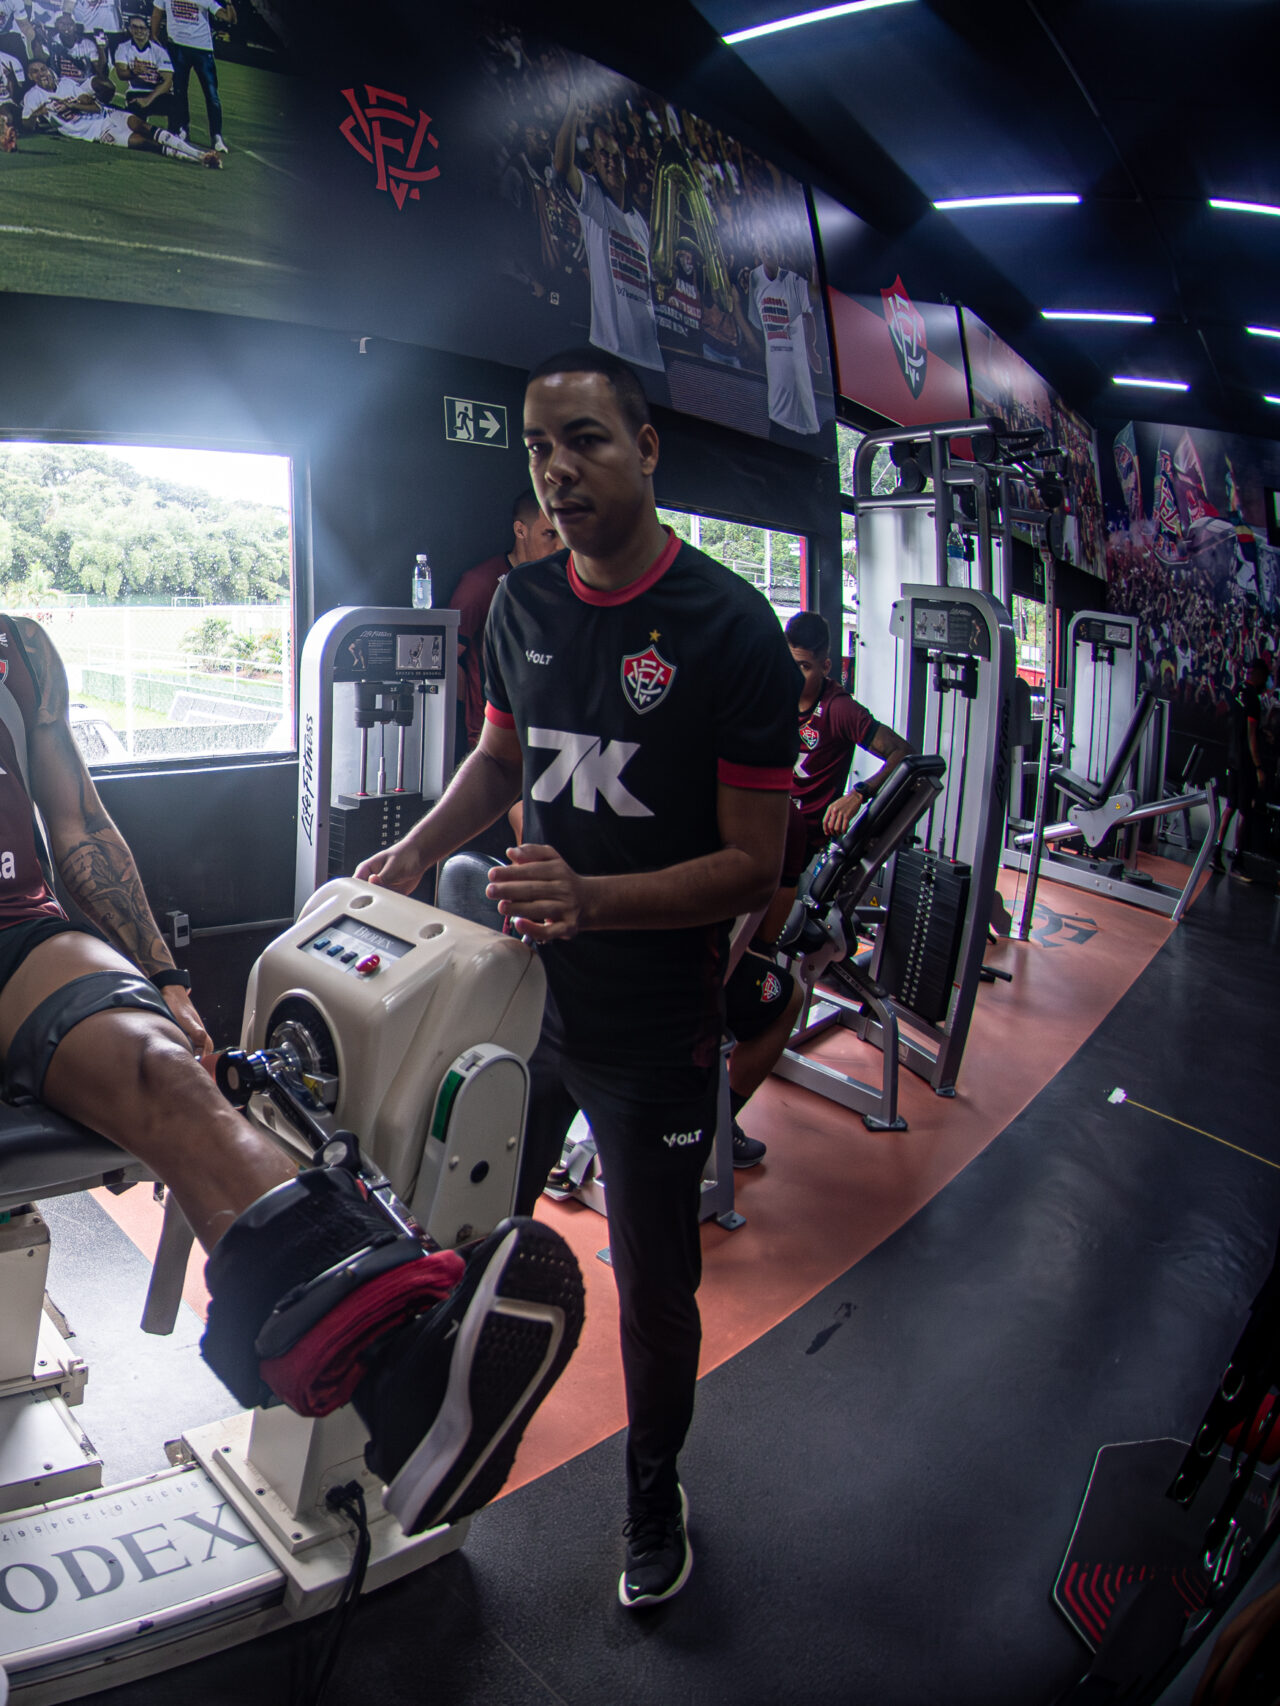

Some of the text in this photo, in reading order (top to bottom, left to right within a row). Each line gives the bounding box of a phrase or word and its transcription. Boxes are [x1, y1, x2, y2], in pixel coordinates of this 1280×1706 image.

[525, 649, 554, 667] VOLT
[527, 727, 655, 818] 7K
[662, 1128, 703, 1148] VOLT
